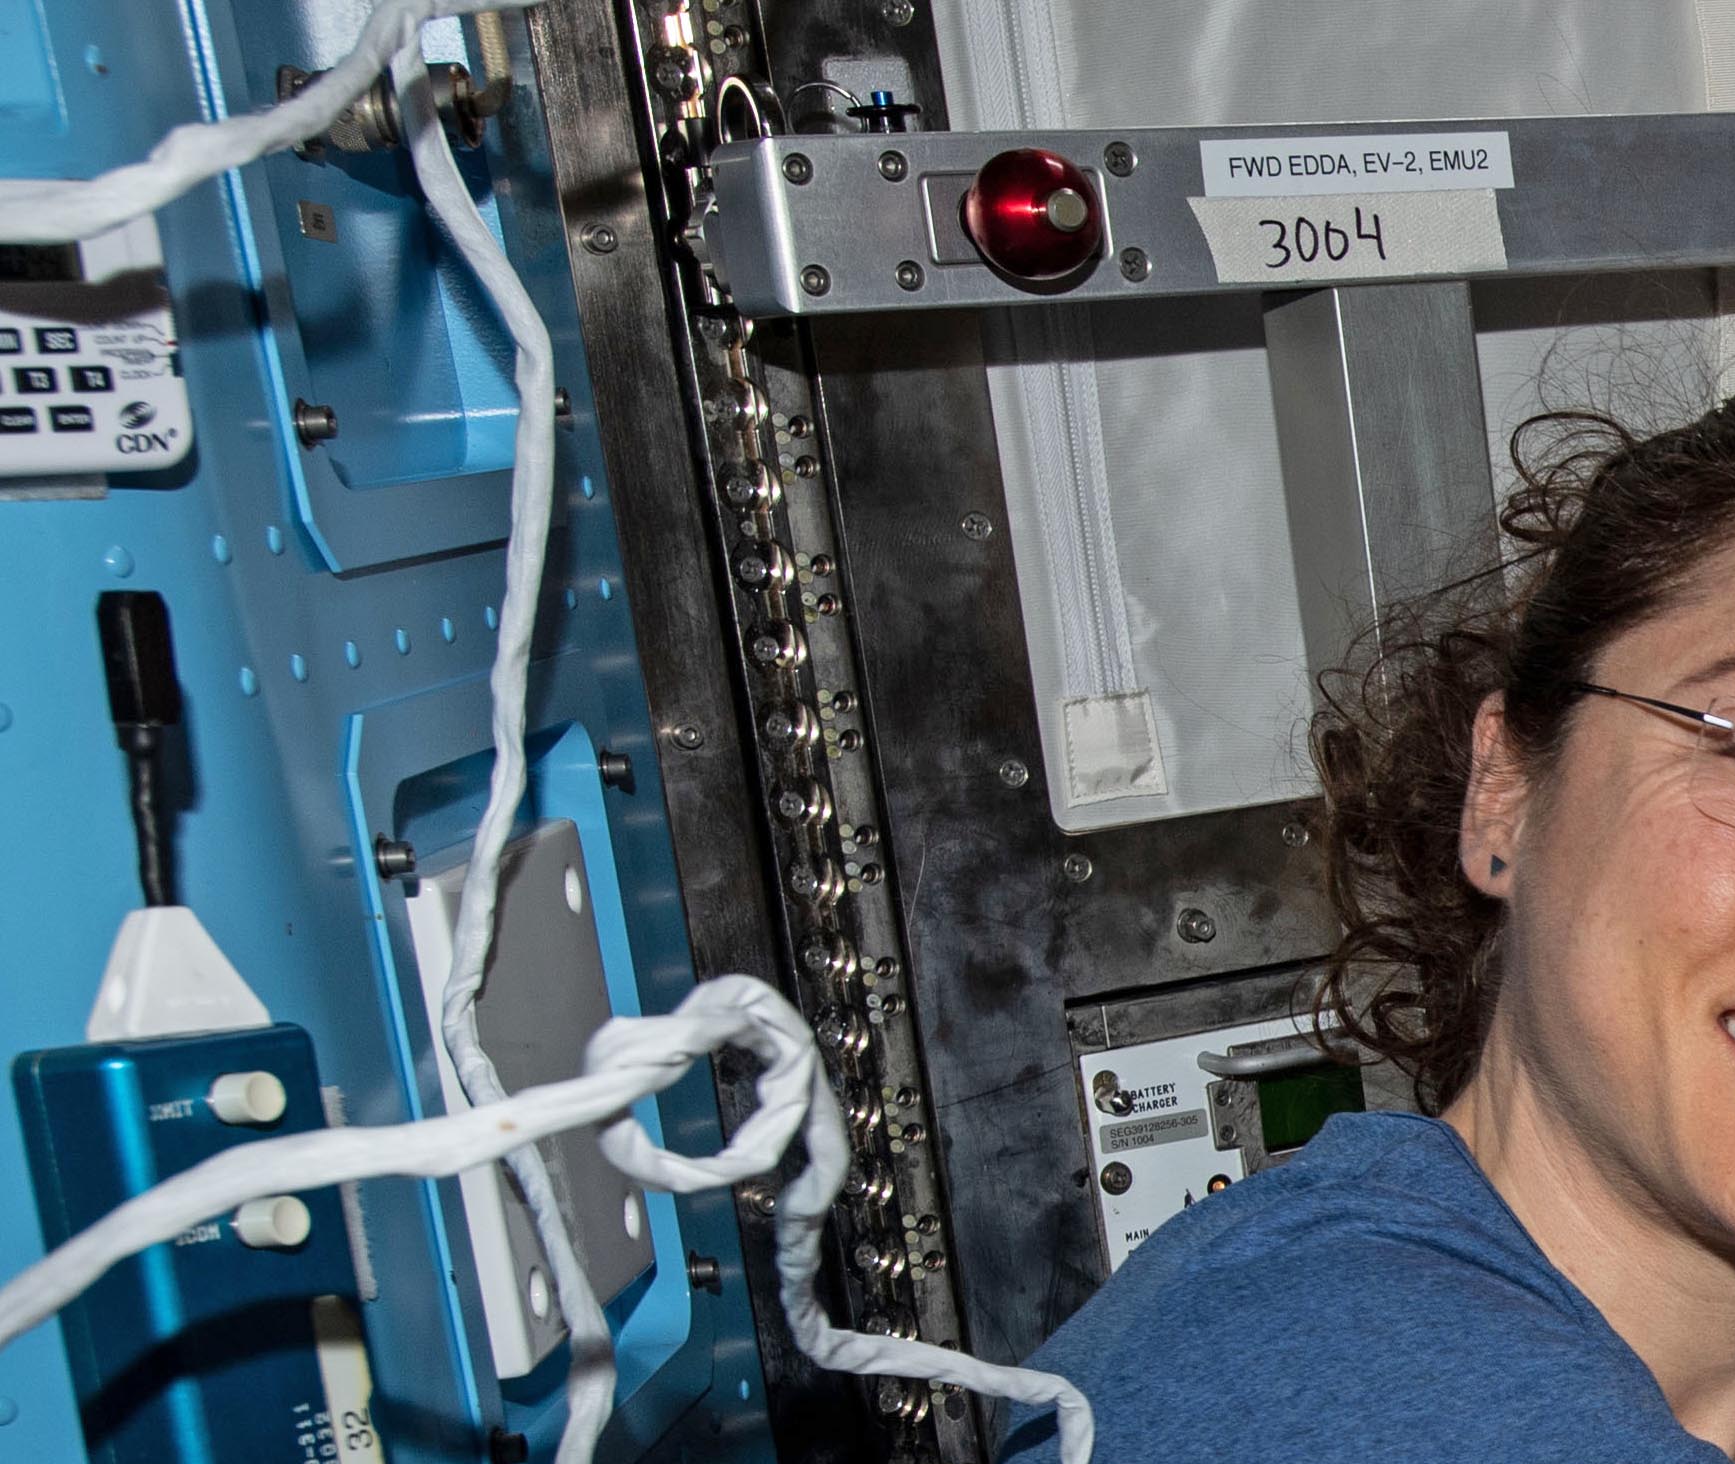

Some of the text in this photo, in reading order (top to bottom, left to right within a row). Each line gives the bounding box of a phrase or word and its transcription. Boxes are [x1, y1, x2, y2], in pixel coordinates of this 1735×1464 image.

[1229, 149, 1490, 178] FWD EDDA, EV-2, EMU2
[1131, 1083, 1176, 1100] BATTERY
[1133, 1097, 1178, 1114] CHARGER
[1111, 1135, 1155, 1150] S/N 1004
[1125, 1228, 1150, 1243] MAIN
[344, 1408, 374, 1451] 32
